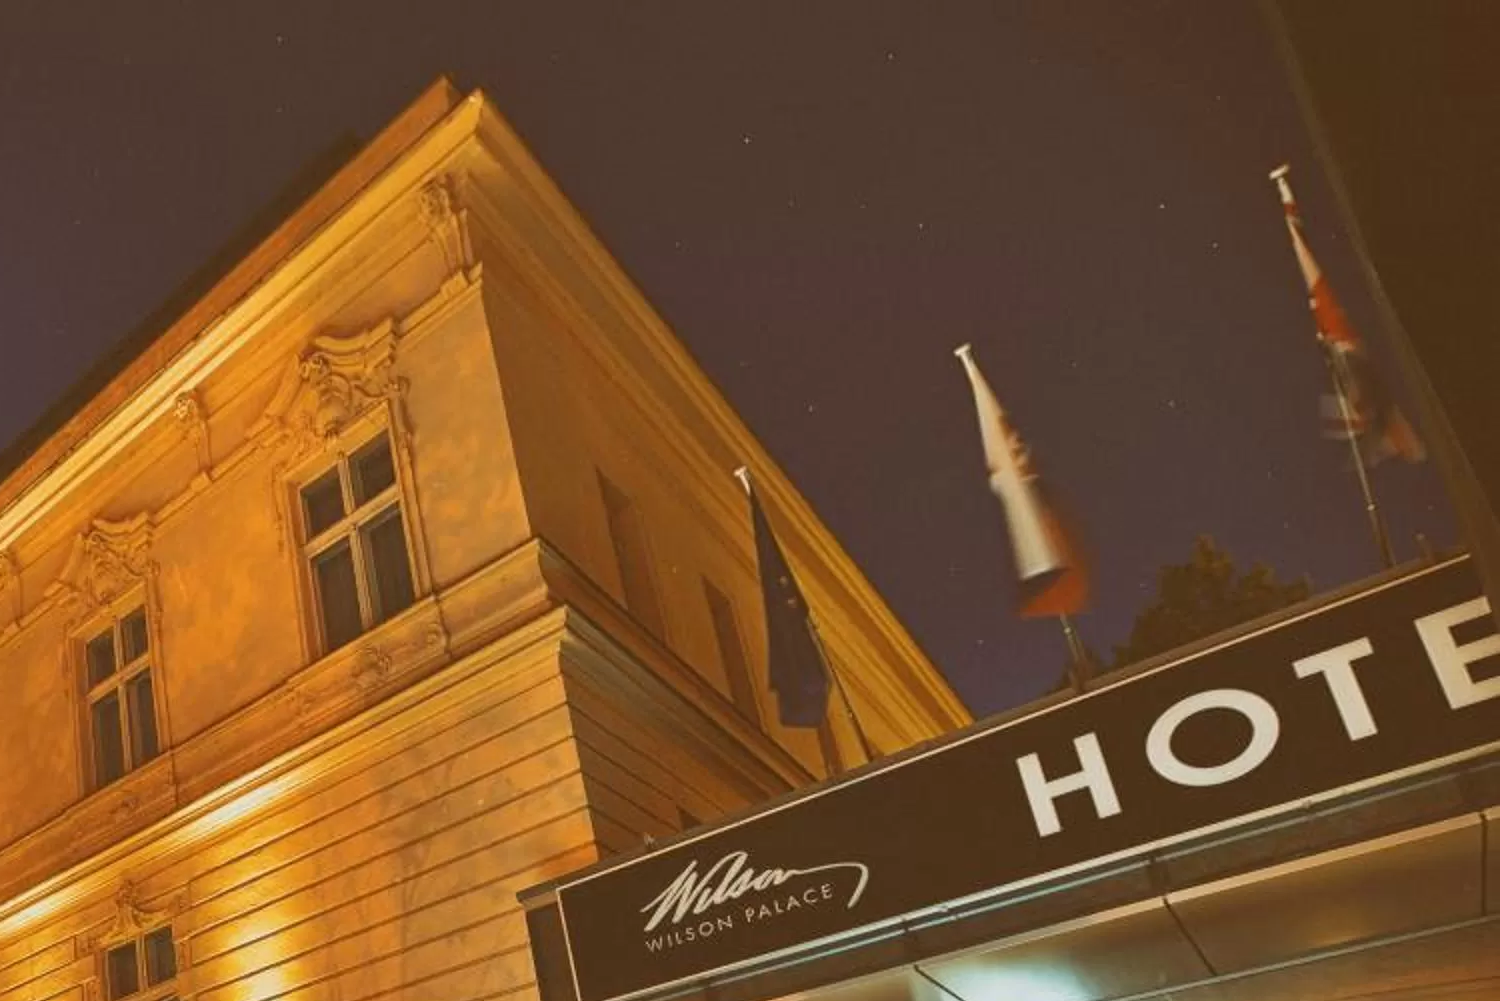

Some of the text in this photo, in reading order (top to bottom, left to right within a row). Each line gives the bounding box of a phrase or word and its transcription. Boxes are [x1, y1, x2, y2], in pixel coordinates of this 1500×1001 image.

[640, 851, 869, 932] Wilson
[645, 882, 834, 952] WILSON PALACE
